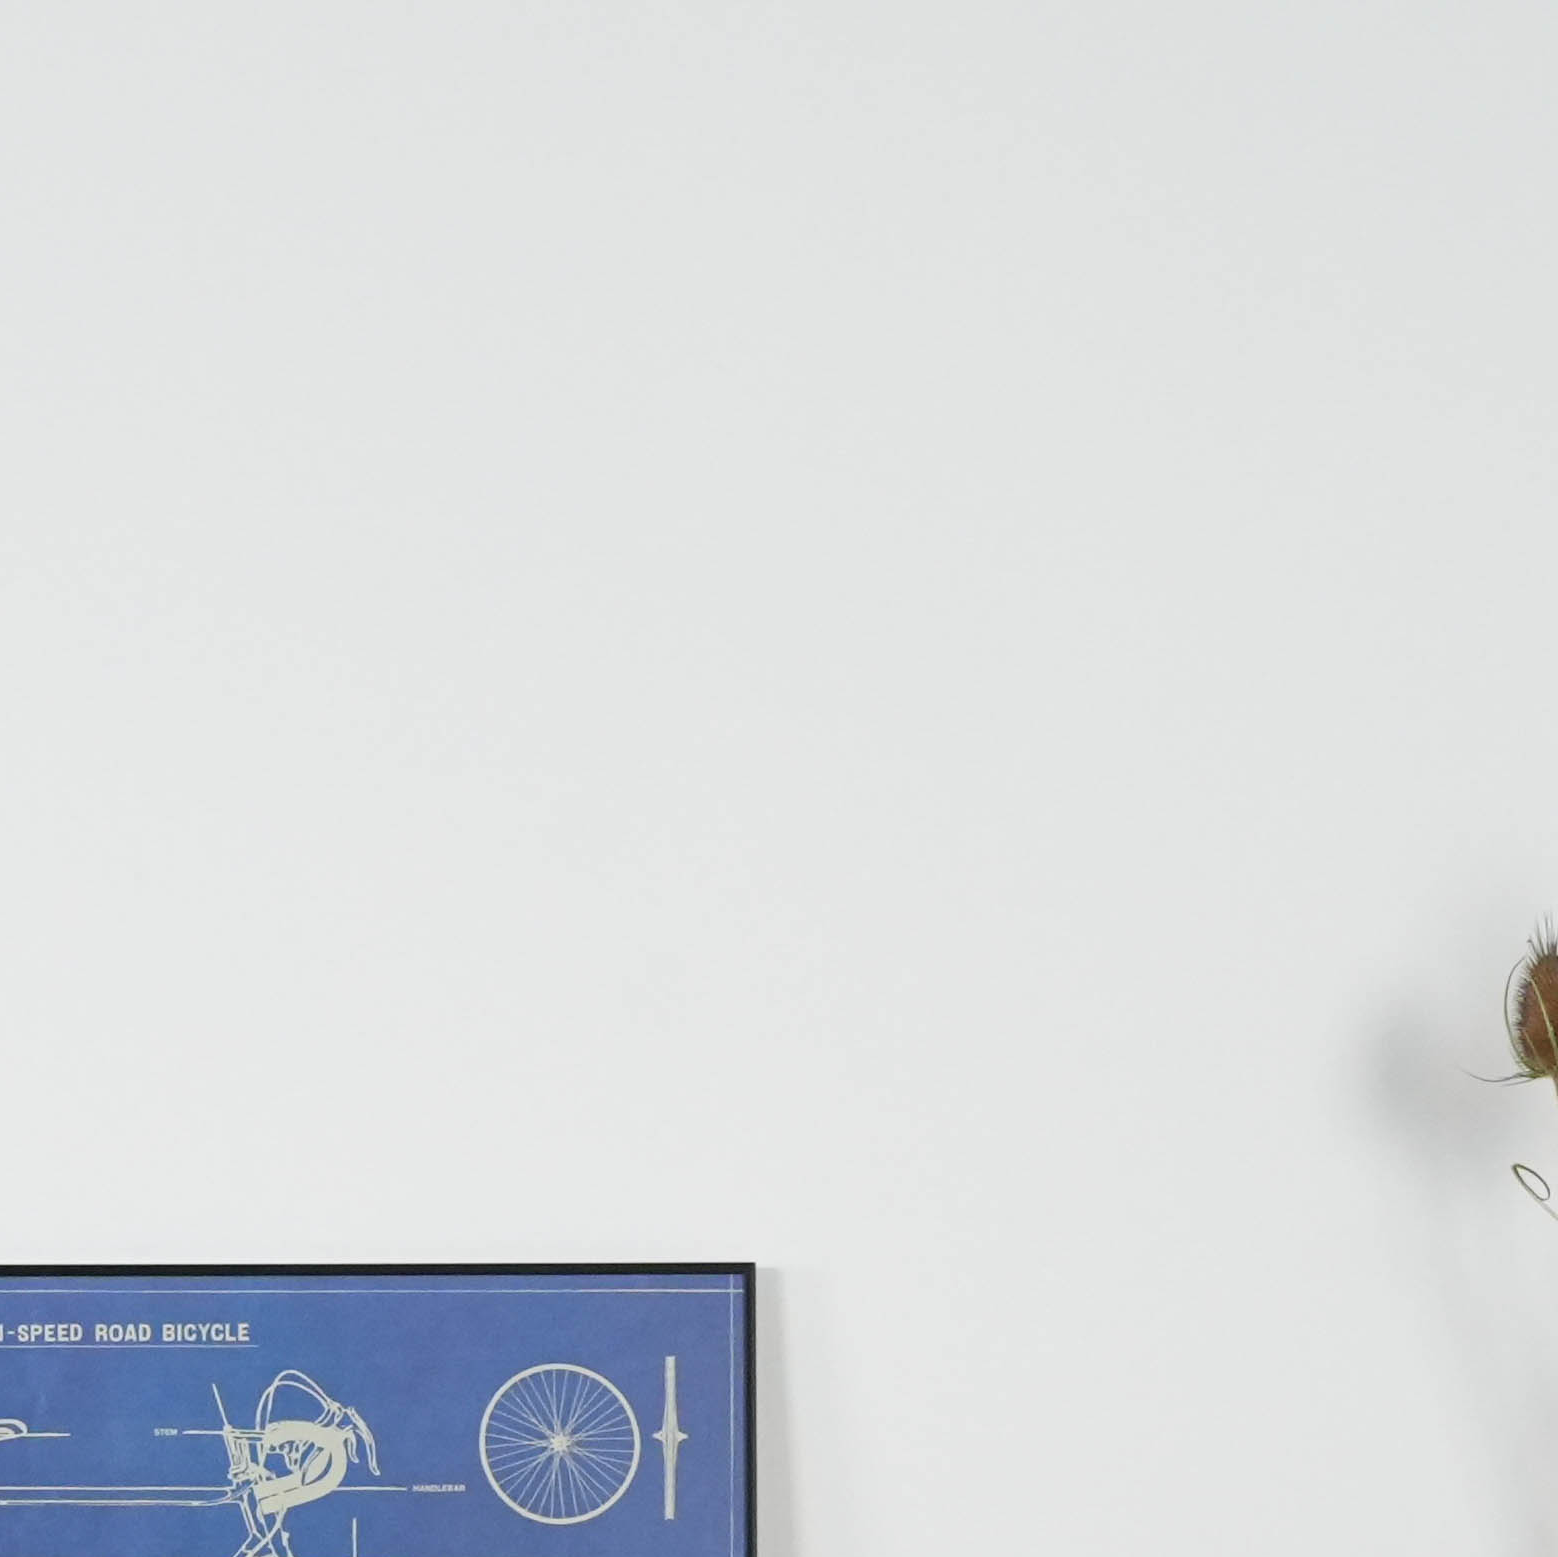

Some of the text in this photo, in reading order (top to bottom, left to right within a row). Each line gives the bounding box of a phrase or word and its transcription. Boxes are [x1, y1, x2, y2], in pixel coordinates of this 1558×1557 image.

[94, 1323, 152, 1342] ROAD
[161, 1322, 250, 1342] BICYCLE
[154, 1428, 179, 1436] STEM
[413, 1484, 466, 1492] HANDLEBAR
